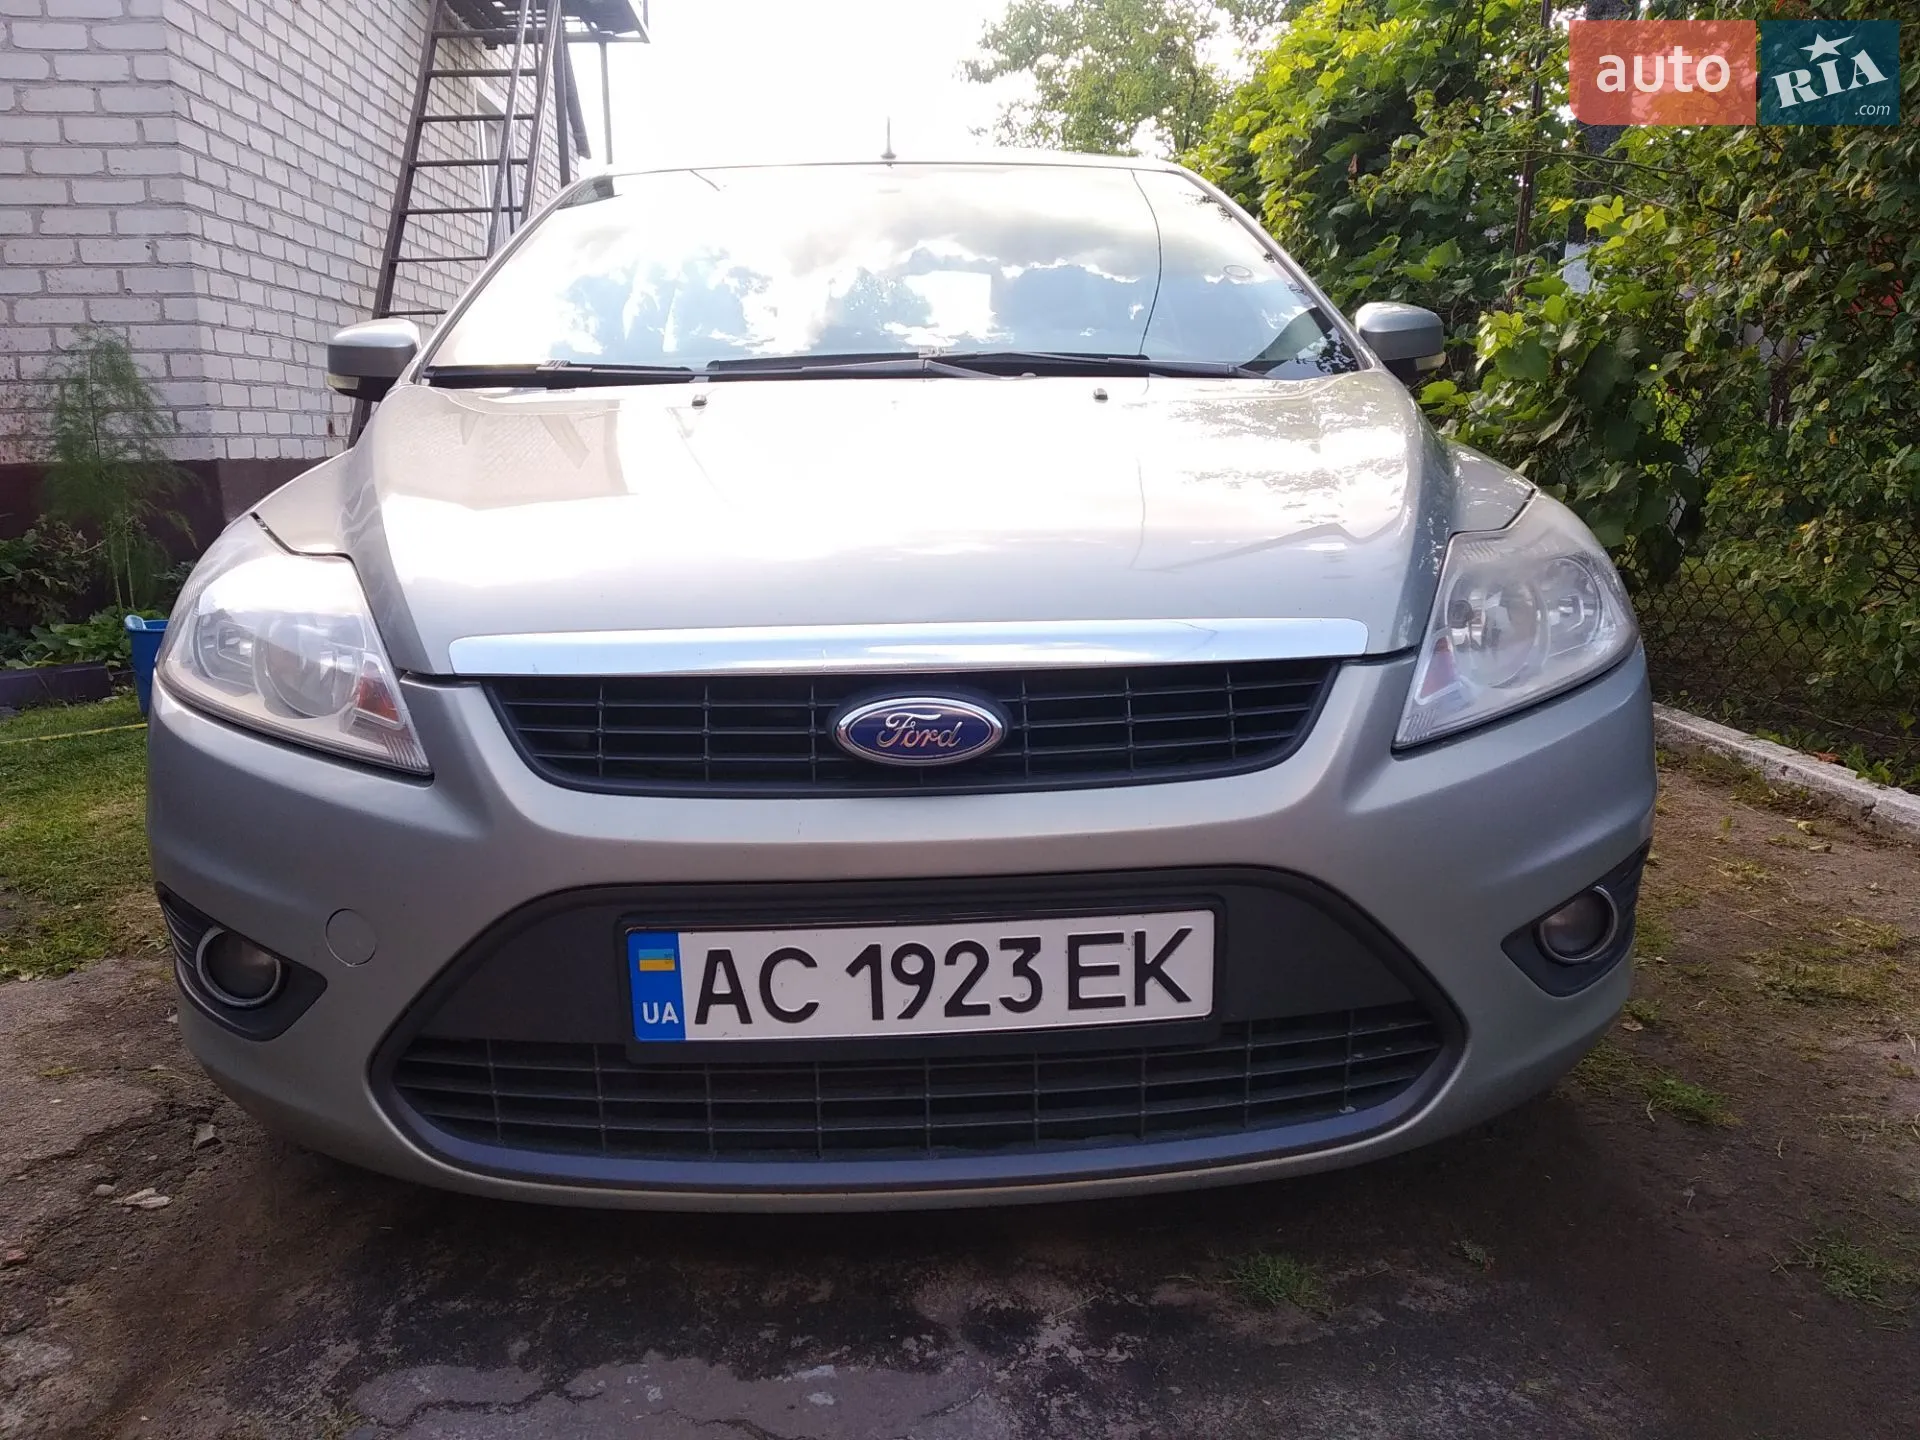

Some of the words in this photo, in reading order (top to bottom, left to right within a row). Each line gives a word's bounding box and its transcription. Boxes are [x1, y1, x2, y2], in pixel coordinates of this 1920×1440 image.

[876, 712, 963, 748] Ford
[694, 946, 820, 1026] AC
[845, 935, 1044, 1021] 1923
[1066, 927, 1194, 1011] EK
[641, 1001, 680, 1026] UA
